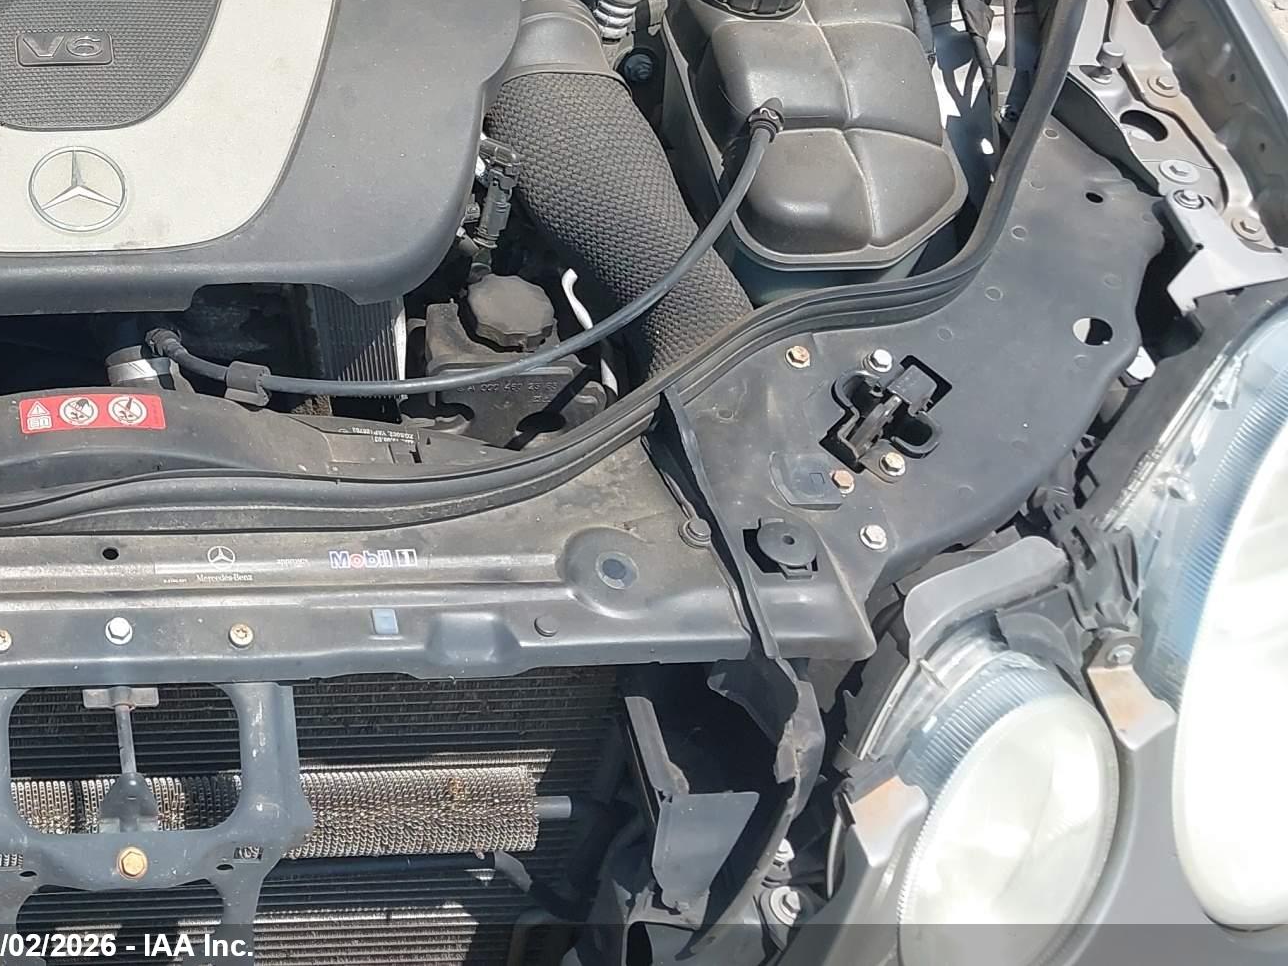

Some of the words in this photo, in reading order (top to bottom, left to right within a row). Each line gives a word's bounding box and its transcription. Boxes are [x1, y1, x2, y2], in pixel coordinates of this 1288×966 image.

[21, 34, 103, 58] V6
[329, 549, 393, 569] Mobil
[396, 549, 417, 567] 1
[196, 572, 253, 583] Mercedes-Benz
